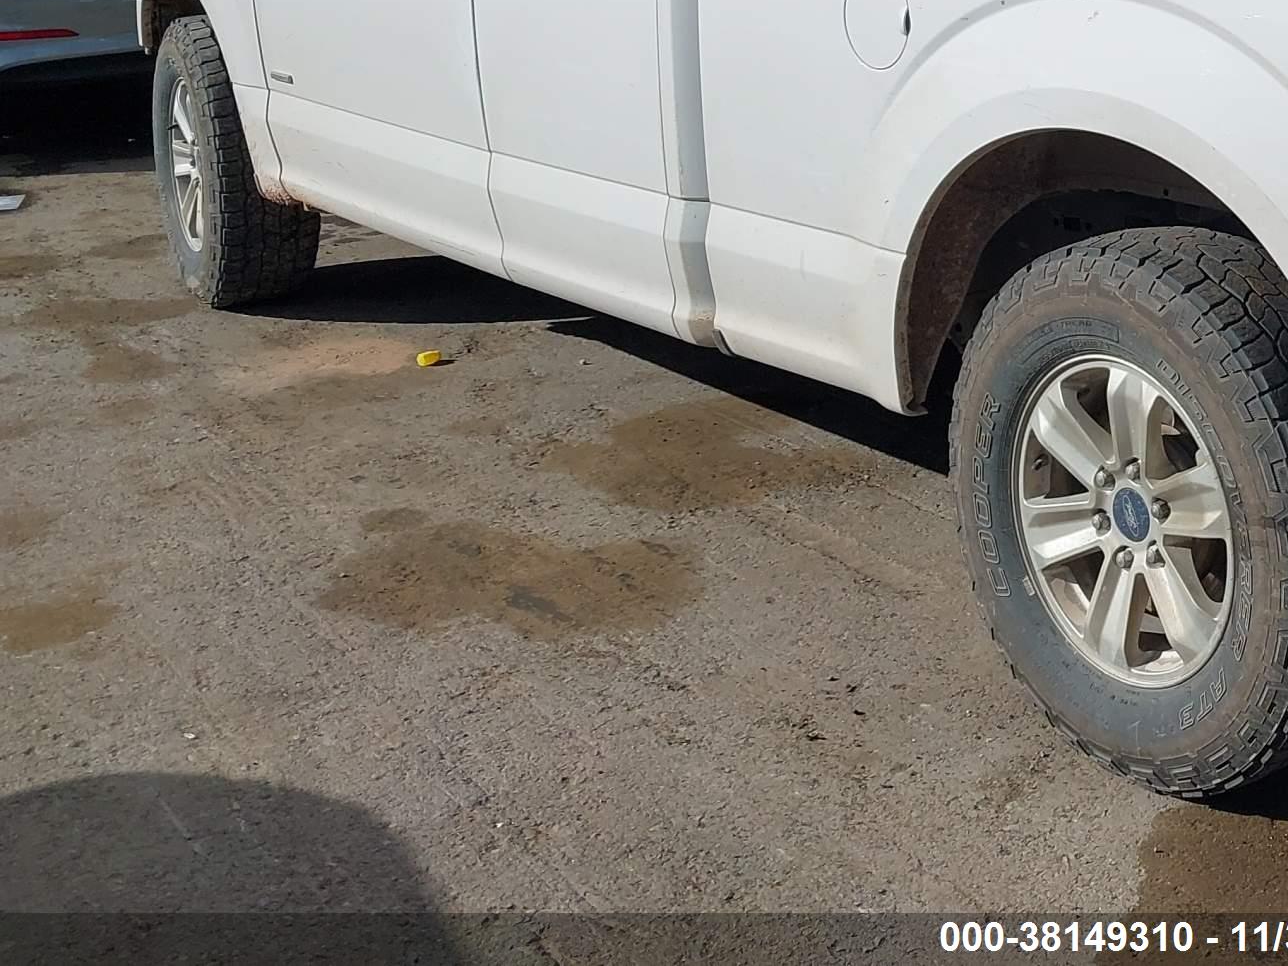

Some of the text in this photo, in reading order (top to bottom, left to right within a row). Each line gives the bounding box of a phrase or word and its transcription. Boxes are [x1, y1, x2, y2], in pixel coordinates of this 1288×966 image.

[972, 392, 1011, 597] COOPER
[1156, 359, 1255, 662] DISCOVERER
[1178, 665, 1229, 732] AT3
